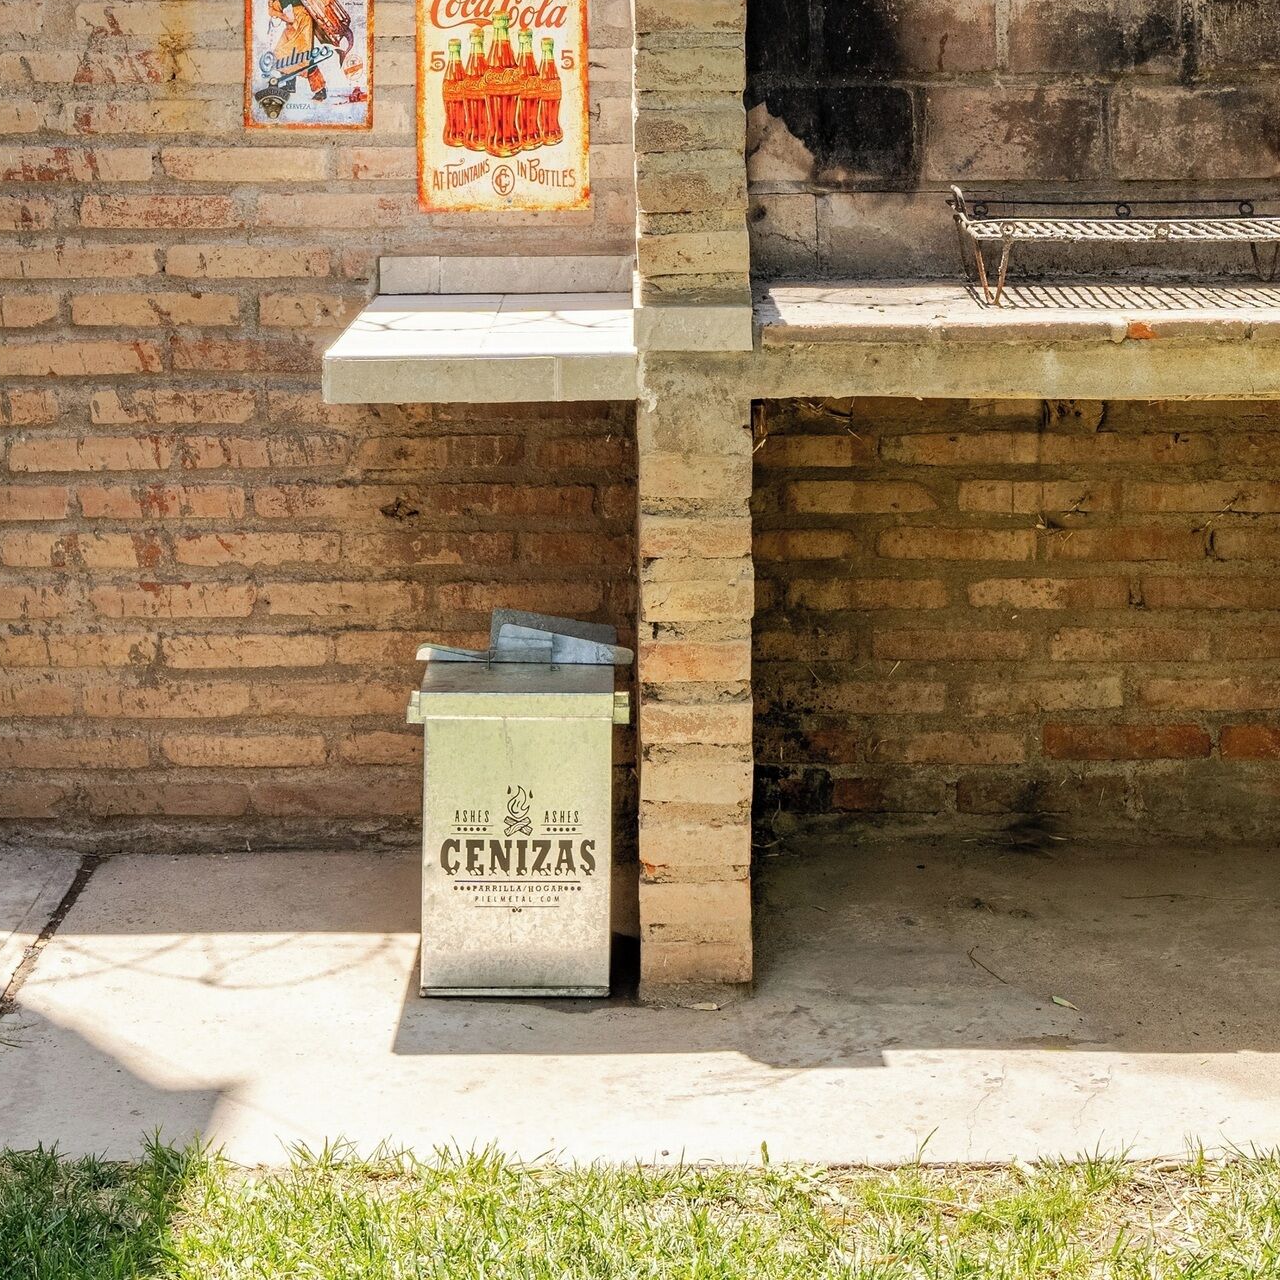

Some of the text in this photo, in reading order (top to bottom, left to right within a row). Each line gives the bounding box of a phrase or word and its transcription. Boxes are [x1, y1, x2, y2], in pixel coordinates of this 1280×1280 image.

[285, 103, 312, 111] CERVEZA
[432, 169, 445, 191] AT
[444, 157, 491, 190] FOUNTAINS
[516, 159, 527, 180] IN
[527, 158, 576, 189] BOTTLES
[454, 809, 490, 823] ASHES
[544, 810, 579, 824] ASHES
[440, 838, 596, 877] CENIZAS
